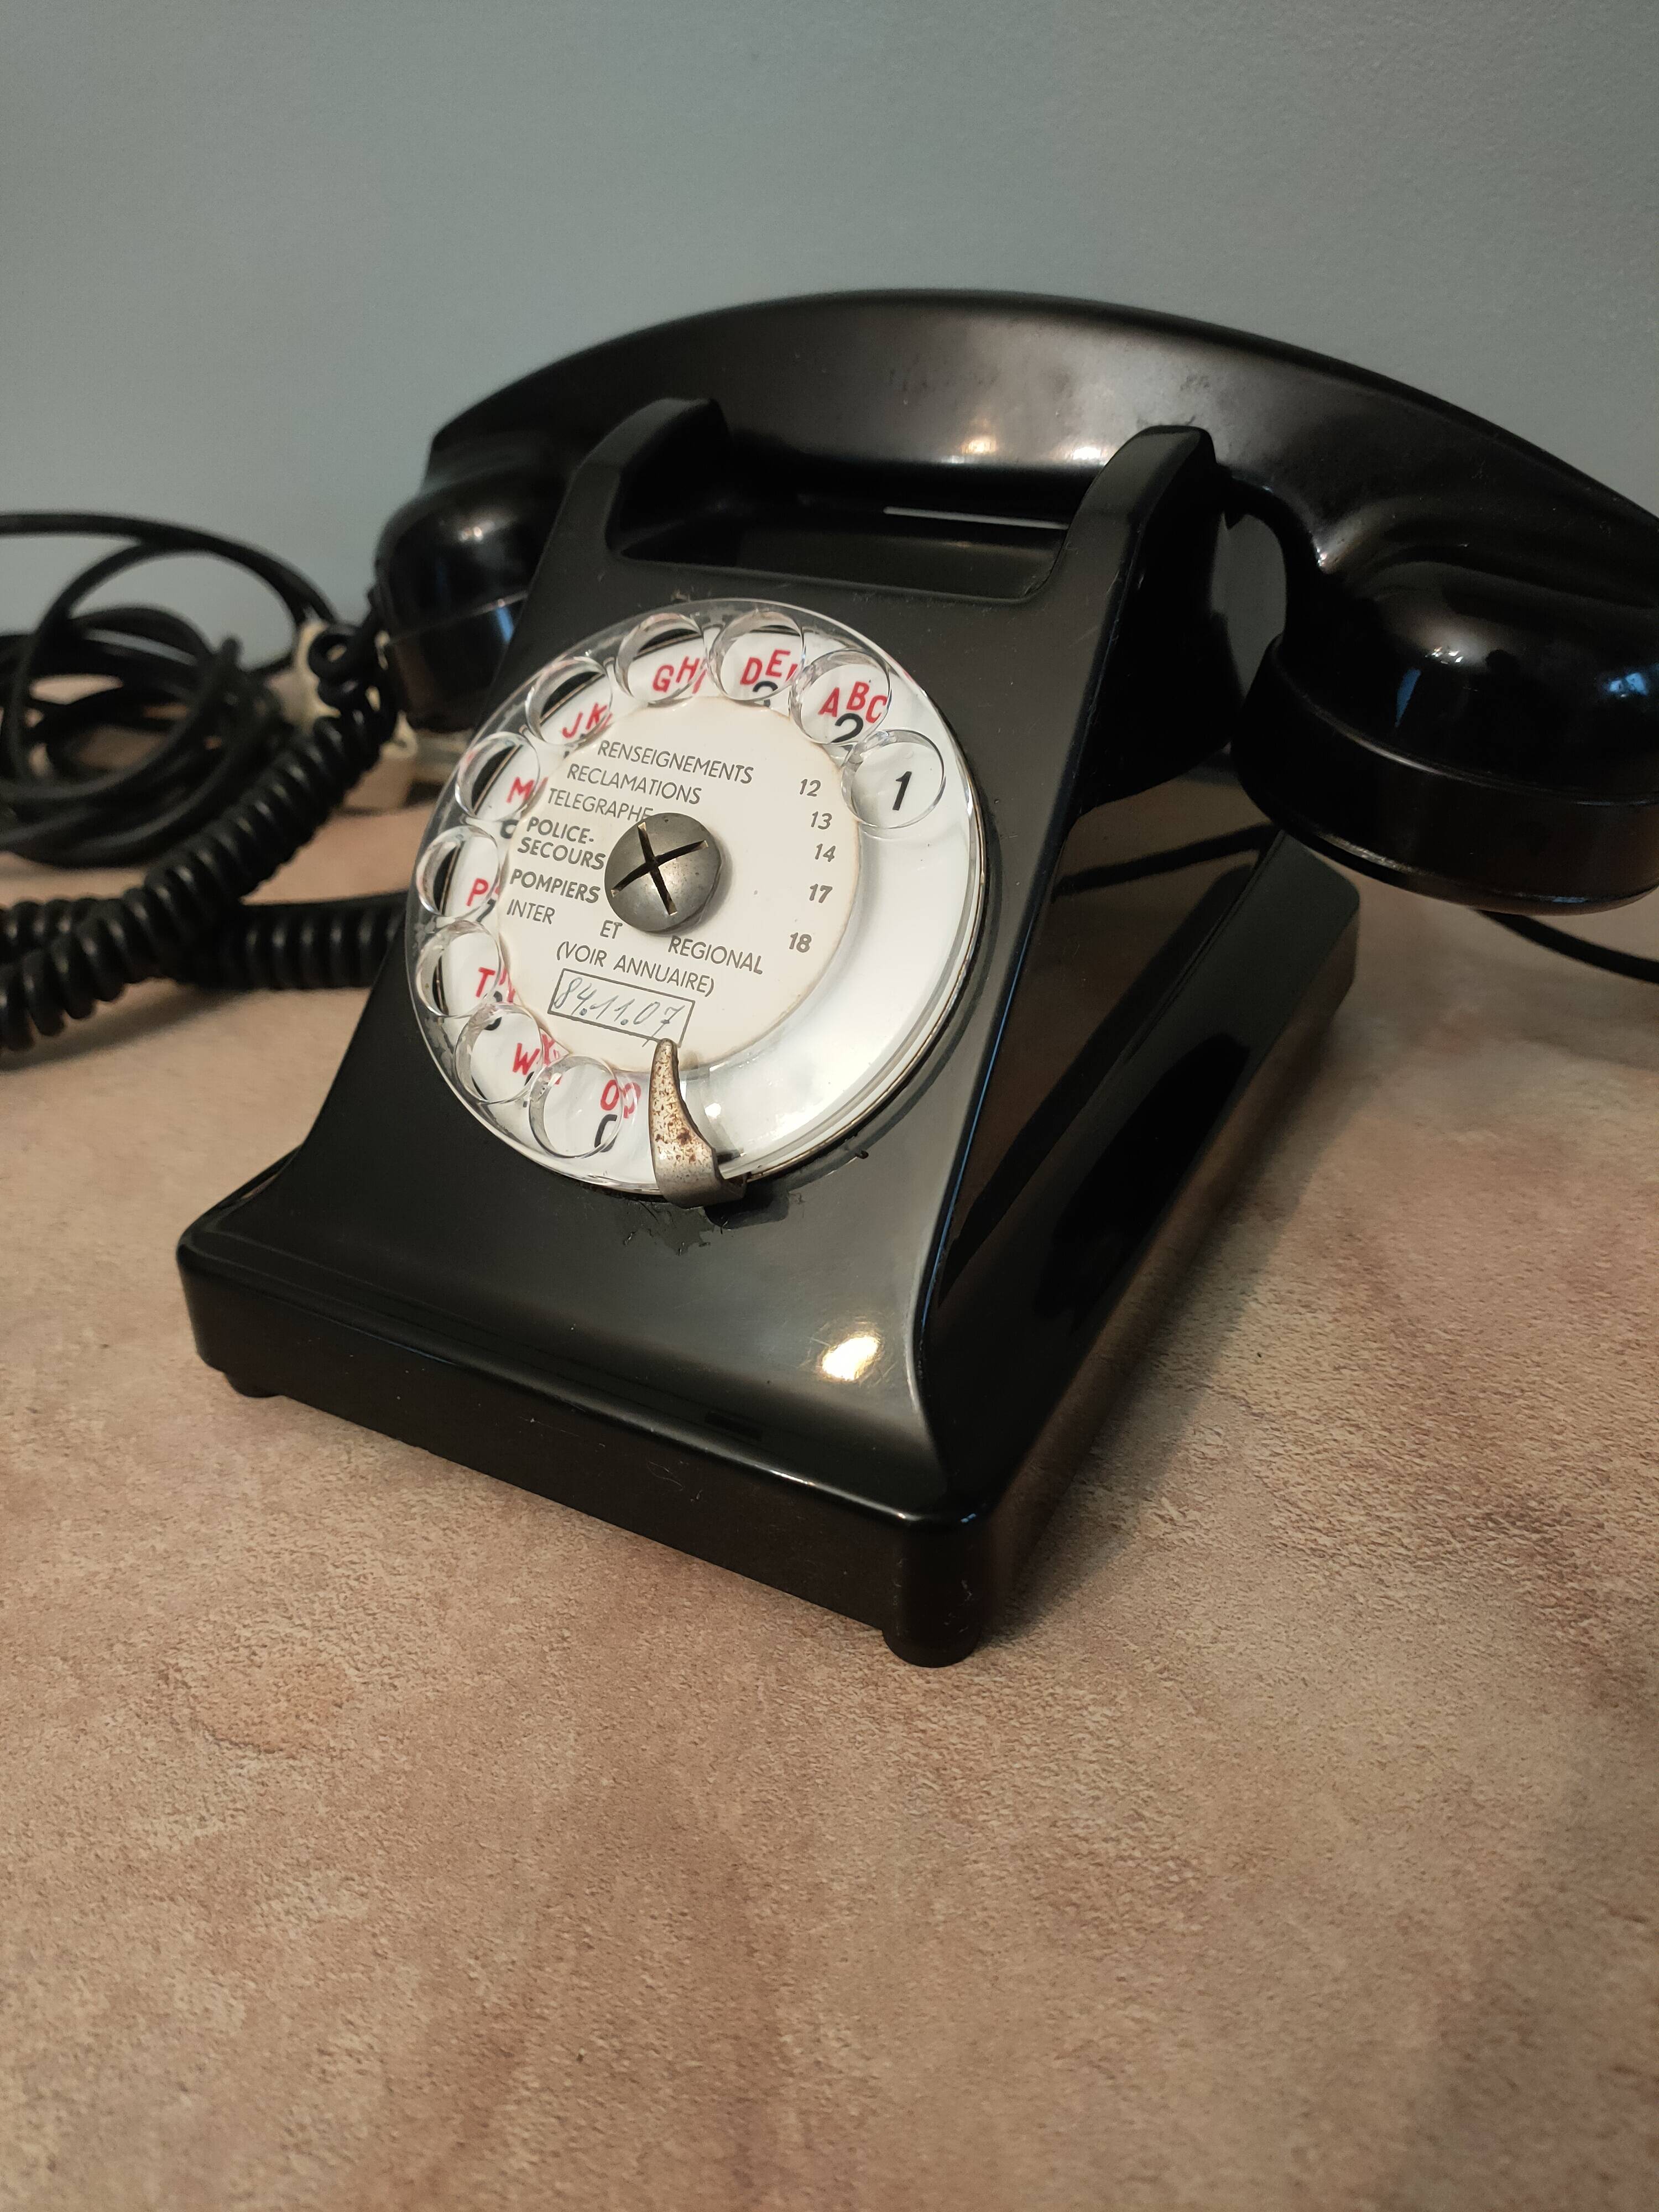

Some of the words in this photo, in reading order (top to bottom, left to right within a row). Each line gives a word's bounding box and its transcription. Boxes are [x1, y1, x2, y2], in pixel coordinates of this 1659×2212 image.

[818, 681, 886, 723] ABC
[567, 763, 702, 805] RECLAMATIONS
[811, 811, 833, 830] 13
[597, 740, 754, 784] RENSEIGNEMENTS
[800, 779, 821, 797] 12
[892, 771, 912, 811] 1
[526, 816, 594, 844] POLICE-
[815, 843, 836, 862] 14
[517, 837, 606, 870] SECOURS
[809, 883, 833, 904] 17
[507, 899, 555, 925] INTER
[600, 920, 623, 940] ET
[667, 935, 763, 975] REGIONAL
[509, 868, 601, 904] POMPIERS
[789, 932, 812, 953] 18
[556, 941, 607, 968] (VOIR
[613, 954, 714, 997] ANNUAIRE)
